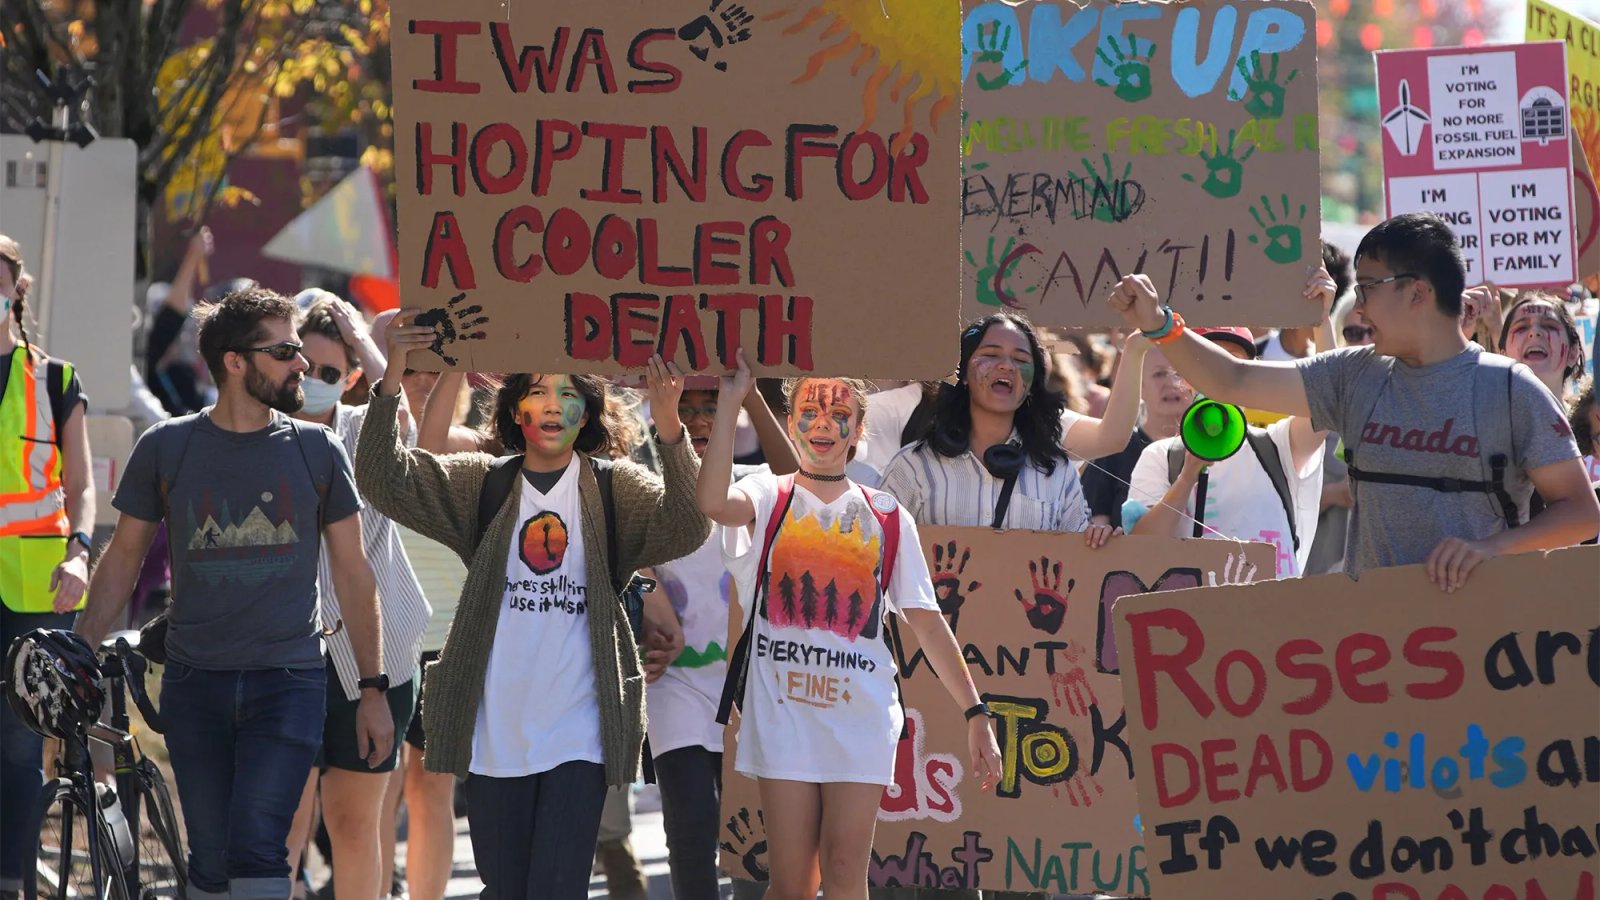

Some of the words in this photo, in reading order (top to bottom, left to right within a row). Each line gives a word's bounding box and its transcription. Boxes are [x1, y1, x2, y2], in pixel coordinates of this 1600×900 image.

[1529, 4, 1557, 38] ITS
[408, 20, 481, 94] I
[490, 21, 683, 94] WAS
[961, 2, 1162, 87] AKE
[1171, 5, 1305, 101] UP
[1461, 65, 1479, 75] I'M
[1446, 80, 1497, 93] VOTING
[1459, 98, 1486, 109] FOR
[1443, 116, 1465, 127] NO
[1466, 113, 1504, 126] MORE
[961, 116, 1036, 156] MELL
[1105, 114, 1218, 158] FRESH
[1435, 131, 1482, 144] FOSSIL
[1485, 129, 1517, 141] FUEL
[415, 119, 774, 203] HOPING
[785, 123, 930, 204] FOR
[1439, 146, 1516, 160] EXPANSION
[962, 172, 1146, 233] EVERMIND
[1421, 188, 1447, 203] I'M
[1511, 183, 1536, 198] I'M
[1489, 206, 1562, 223] VOTING
[421, 210, 477, 289] A
[492, 205, 796, 287] COOLER
[1490, 232, 1527, 248] FOR
[1534, 230, 1562, 244] MY
[1493, 254, 1562, 271] FAMILY
[564, 292, 814, 371] DEATH
[1361, 417, 1480, 458] anada
[505, 575, 538, 593] here's
[509, 595, 535, 612] use
[1125, 608, 1465, 731] Roses
[1151, 729, 1333, 808] DEAD
[1155, 815, 1240, 875] If
[1254, 829, 1338, 876] we
[1349, 806, 1494, 879] don't
[1500, 805, 1600, 866] cha
[1005, 836, 1151, 896] NATUR
